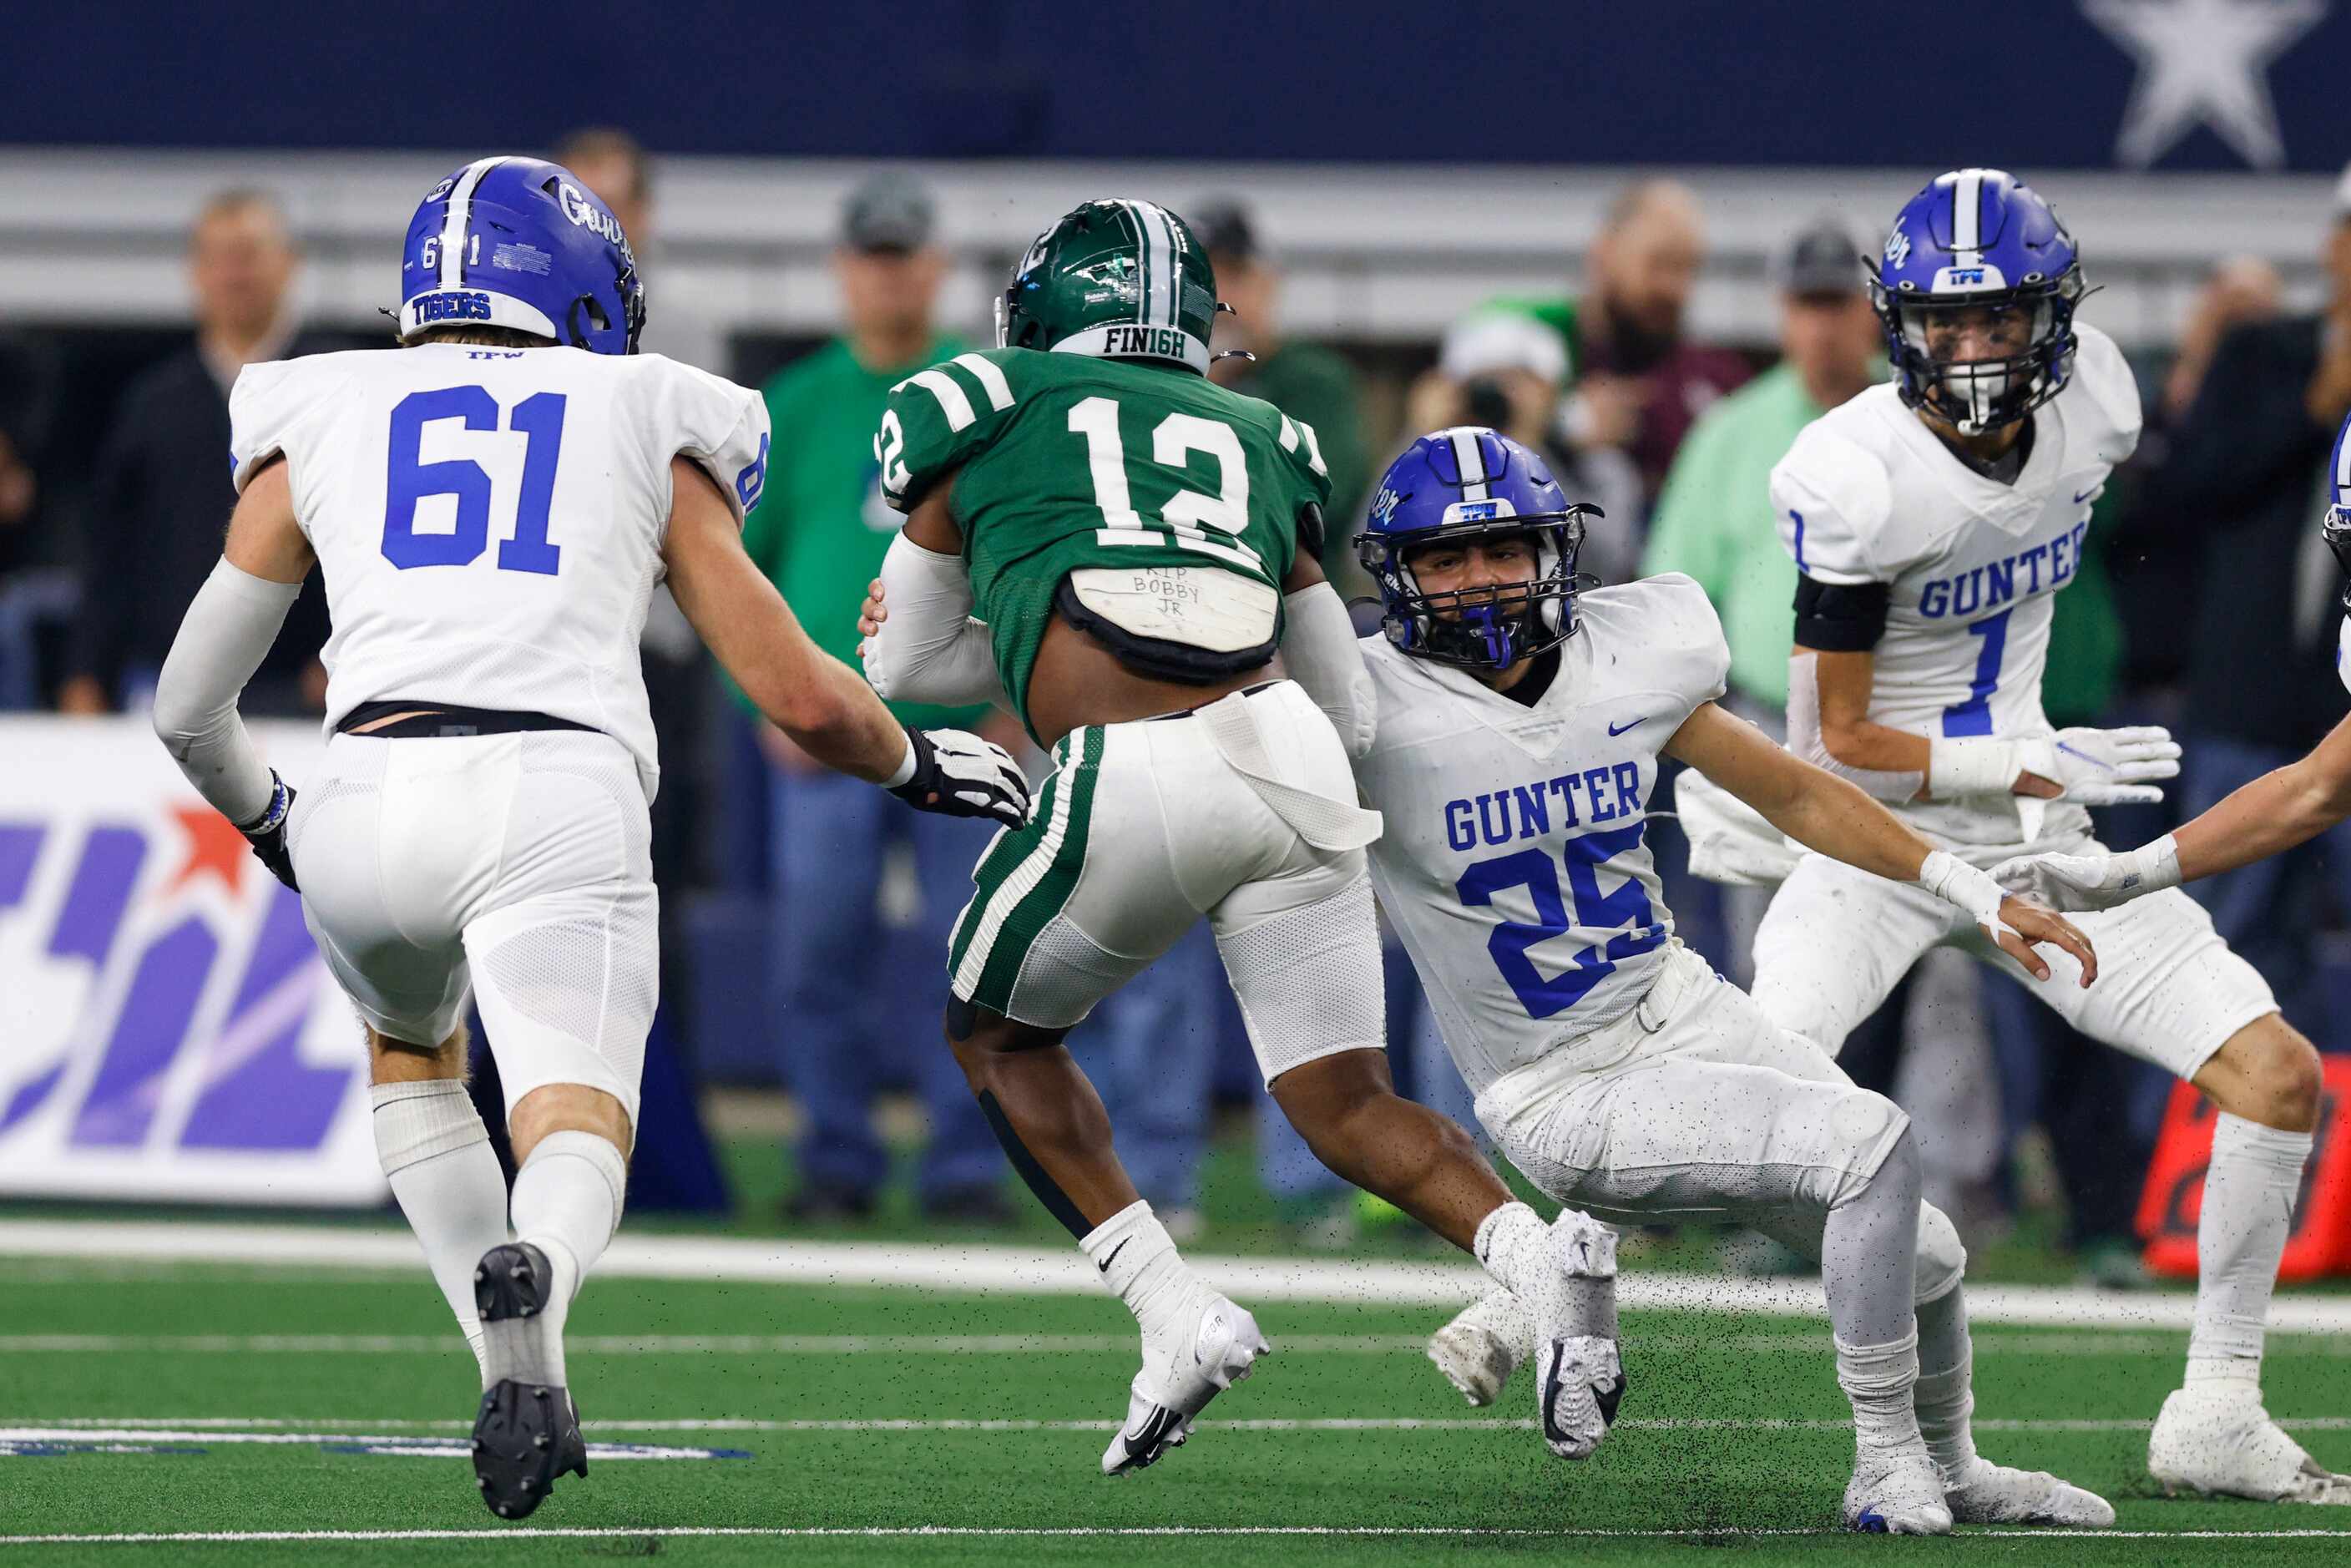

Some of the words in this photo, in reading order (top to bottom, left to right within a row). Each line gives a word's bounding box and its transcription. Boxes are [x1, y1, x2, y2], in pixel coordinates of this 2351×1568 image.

[412, 292, 491, 326] TIGERS
[1104, 326, 1186, 359] FIN16H
[465, 351, 525, 360] TPW
[381, 385, 567, 576] 61
[736, 432, 769, 514] 6
[1068, 396, 1265, 576] 12
[1134, 577, 1198, 604] BOBBY
[1155, 598, 1183, 616] JR
[1942, 607, 2013, 738] 1
[1444, 761, 1641, 852] GUNTER
[1455, 821, 1668, 1019] 25
